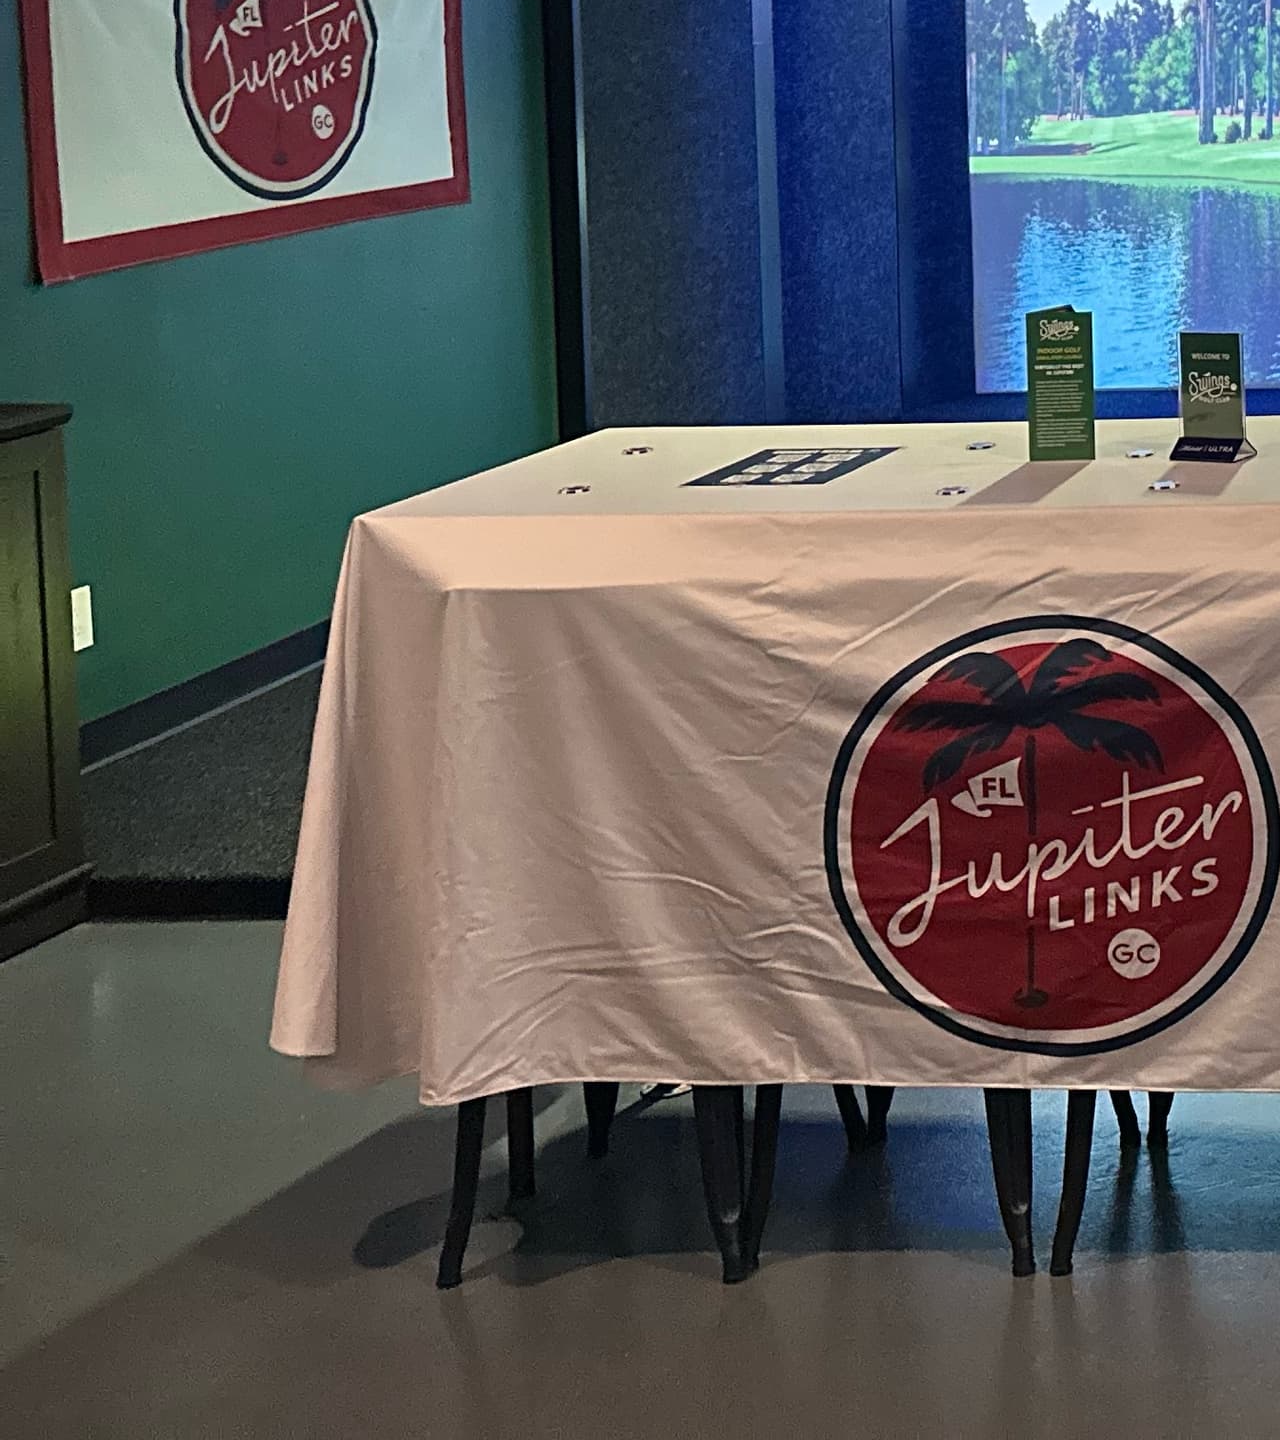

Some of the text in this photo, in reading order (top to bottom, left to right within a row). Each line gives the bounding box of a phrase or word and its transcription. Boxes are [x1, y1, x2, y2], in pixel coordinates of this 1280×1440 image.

[243, 7, 257, 22] FL
[204, 0, 358, 134] Jupiter
[278, 54, 353, 112] LINKS
[314, 111, 333, 131] GC
[1191, 352, 1221, 361] WELCOME
[1188, 371, 1231, 402] Swings
[1208, 444, 1234, 453] ULTRA
[981, 776, 1016, 800] FL
[880, 771, 1243, 949] Jupiter
[1048, 857, 1219, 932] LINKS
[1111, 942, 1157, 966] GC
